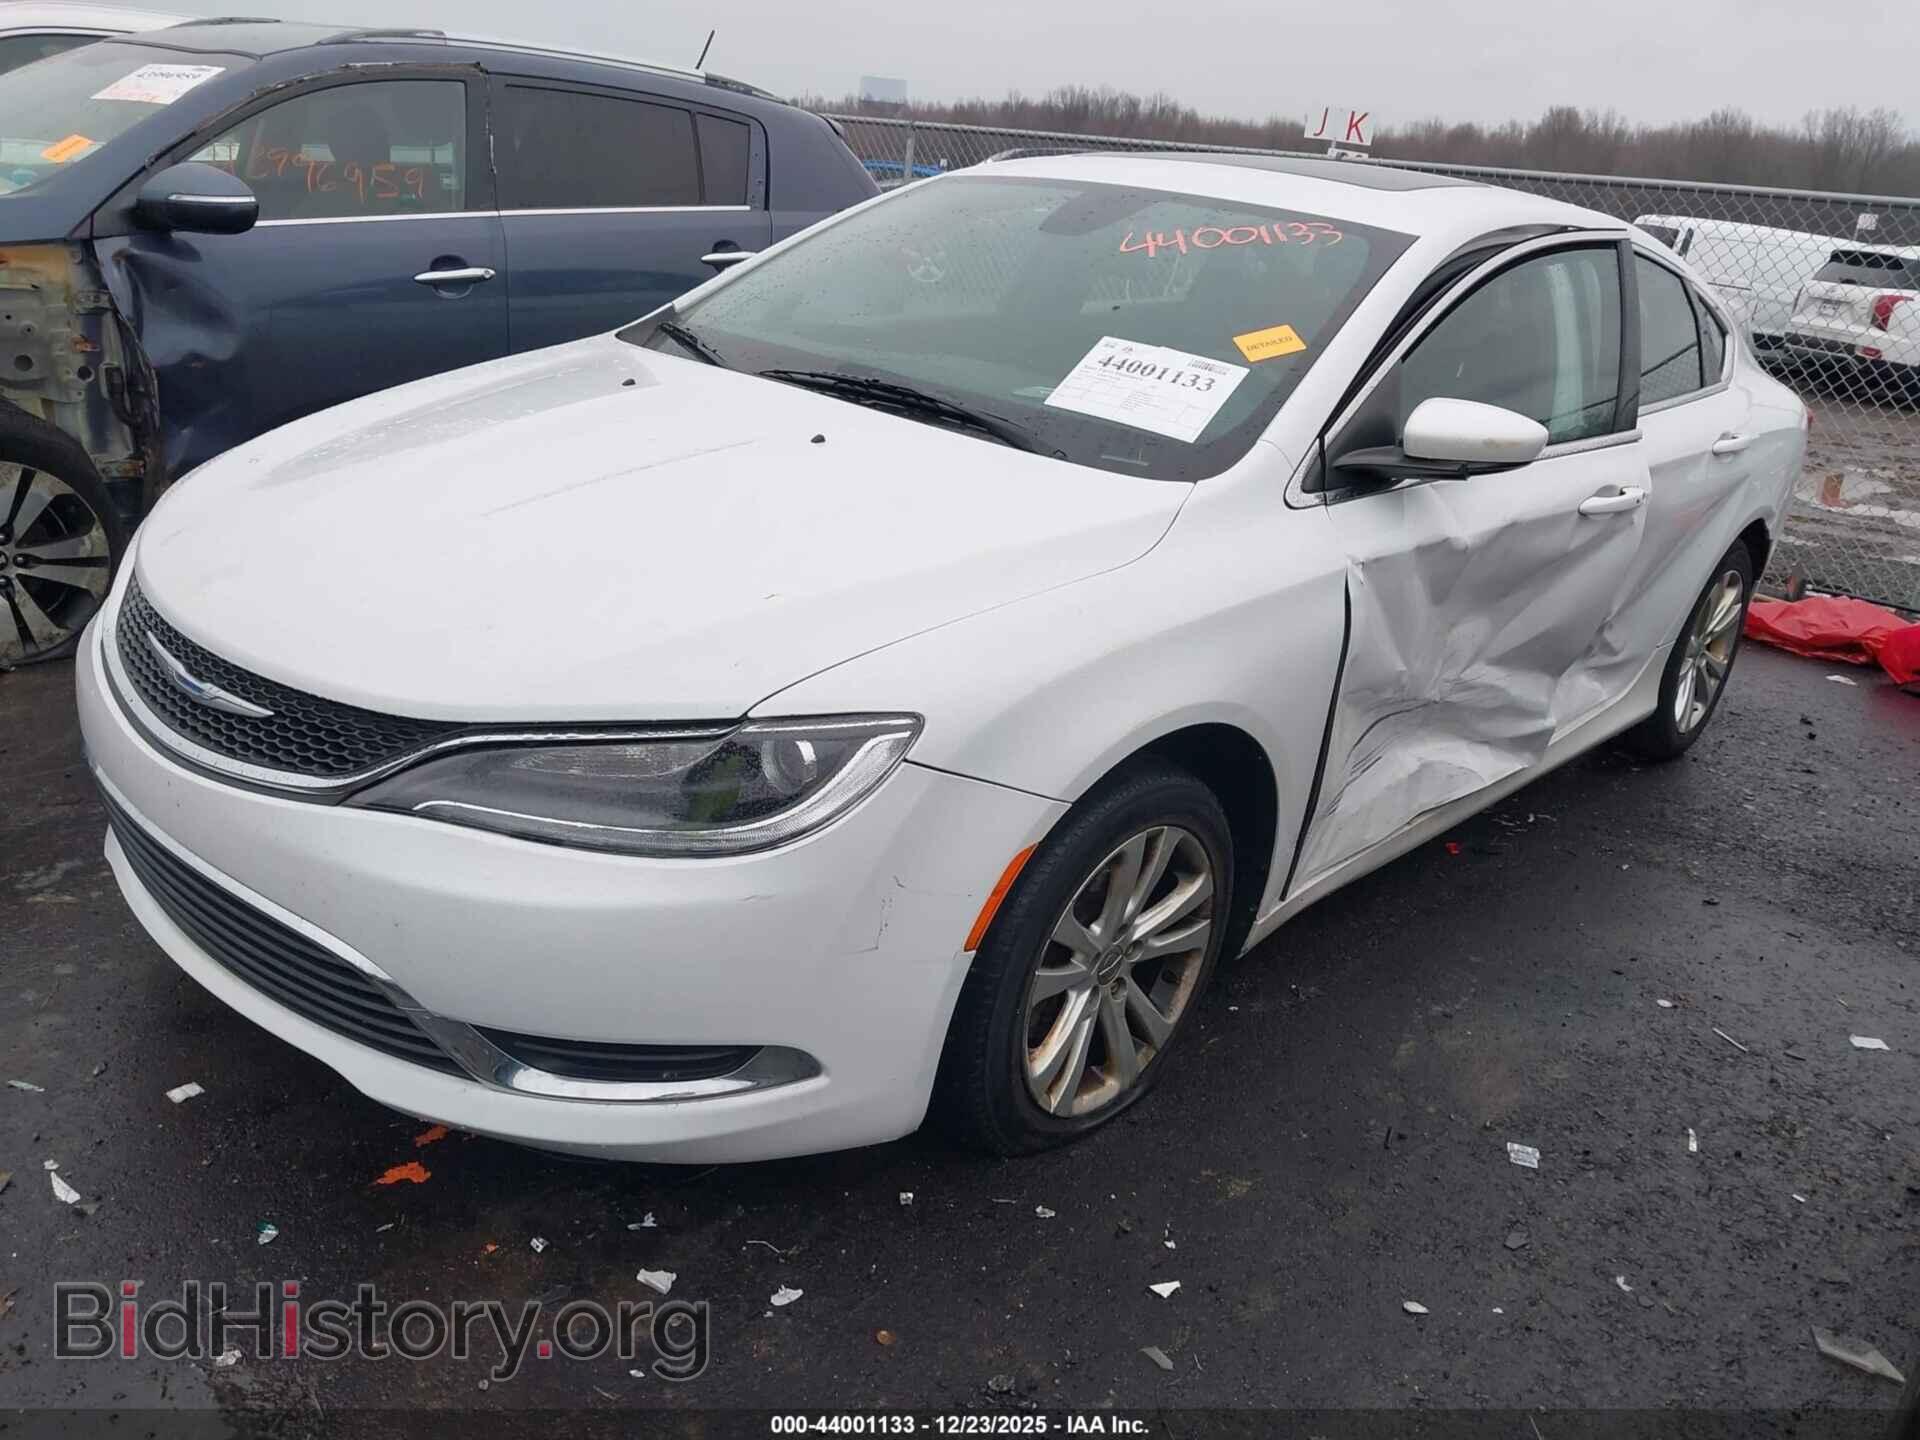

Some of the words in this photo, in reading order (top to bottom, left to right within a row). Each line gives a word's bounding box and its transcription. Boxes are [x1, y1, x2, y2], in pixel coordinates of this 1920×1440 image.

[1313, 107, 1329, 136] J
[1346, 110, 1369, 143] K
[228, 145, 424, 204] 996959
[1120, 222, 1343, 257] 44001133
[1097, 354, 1216, 392] 44001133
